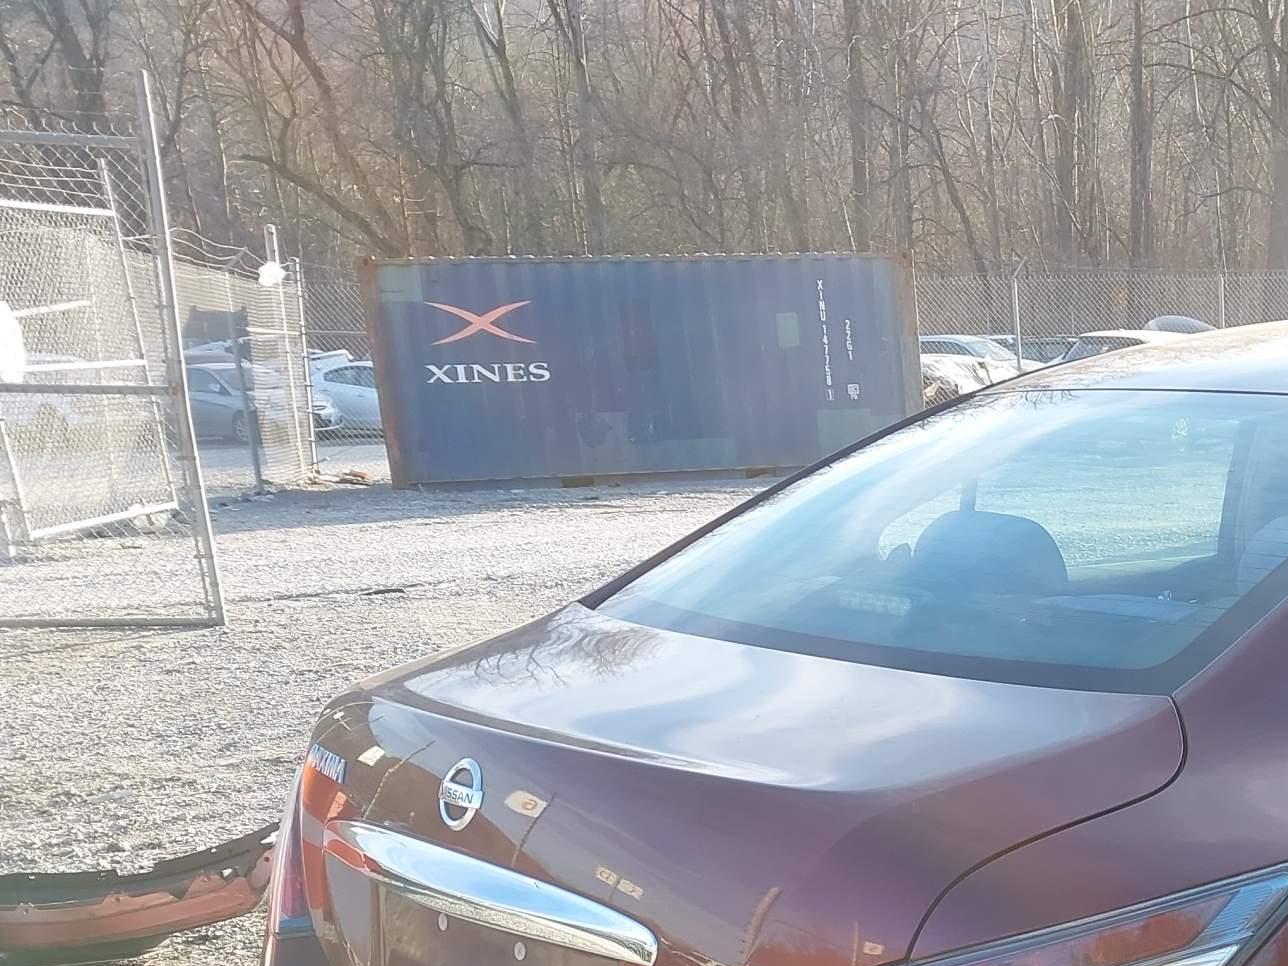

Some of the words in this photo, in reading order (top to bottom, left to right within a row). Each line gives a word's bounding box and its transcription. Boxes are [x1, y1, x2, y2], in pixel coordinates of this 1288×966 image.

[816, 279, 826, 321] XINU
[822, 324, 832, 386] 147758
[844, 319, 853, 361] 22G1
[426, 362, 550, 384] XINES
[439, 781, 474, 805] NISSAN
